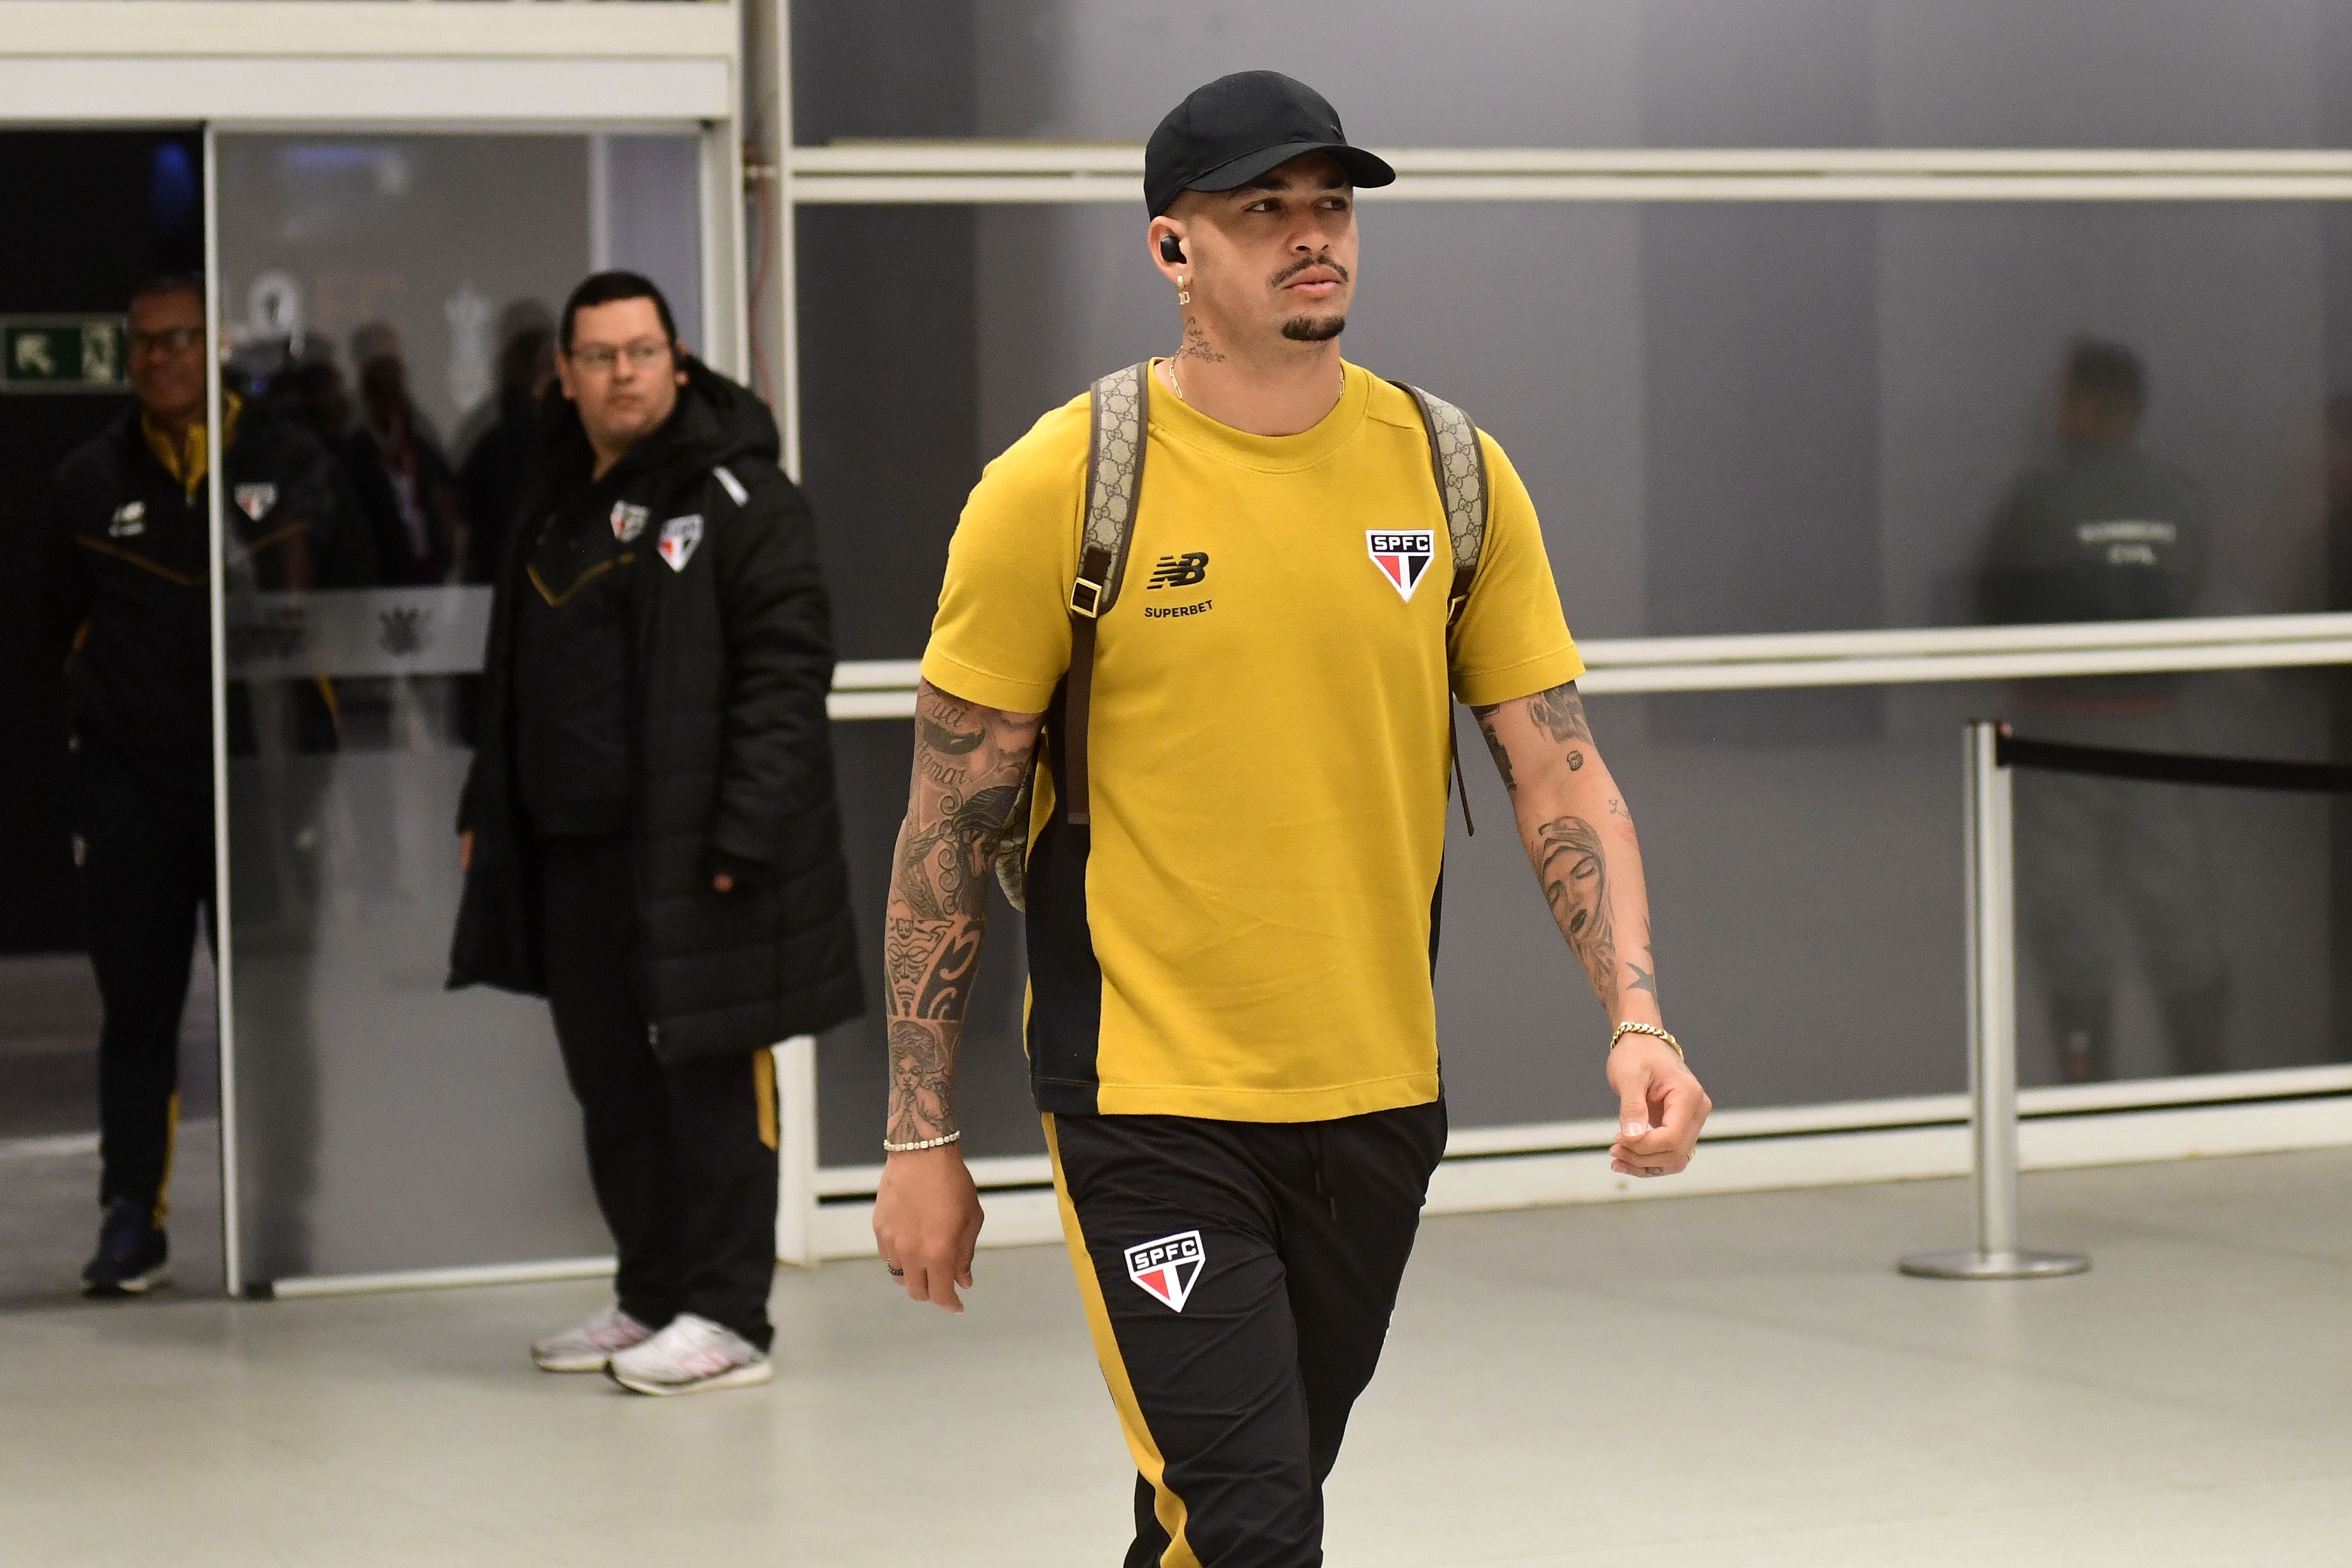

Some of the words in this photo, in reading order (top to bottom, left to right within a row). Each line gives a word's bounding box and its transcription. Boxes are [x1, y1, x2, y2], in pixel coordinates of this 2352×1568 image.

[1374, 536, 1429, 551] SPFC
[1144, 599, 1212, 618] SUPERBET
[1134, 1240, 1197, 1270] SPFC
